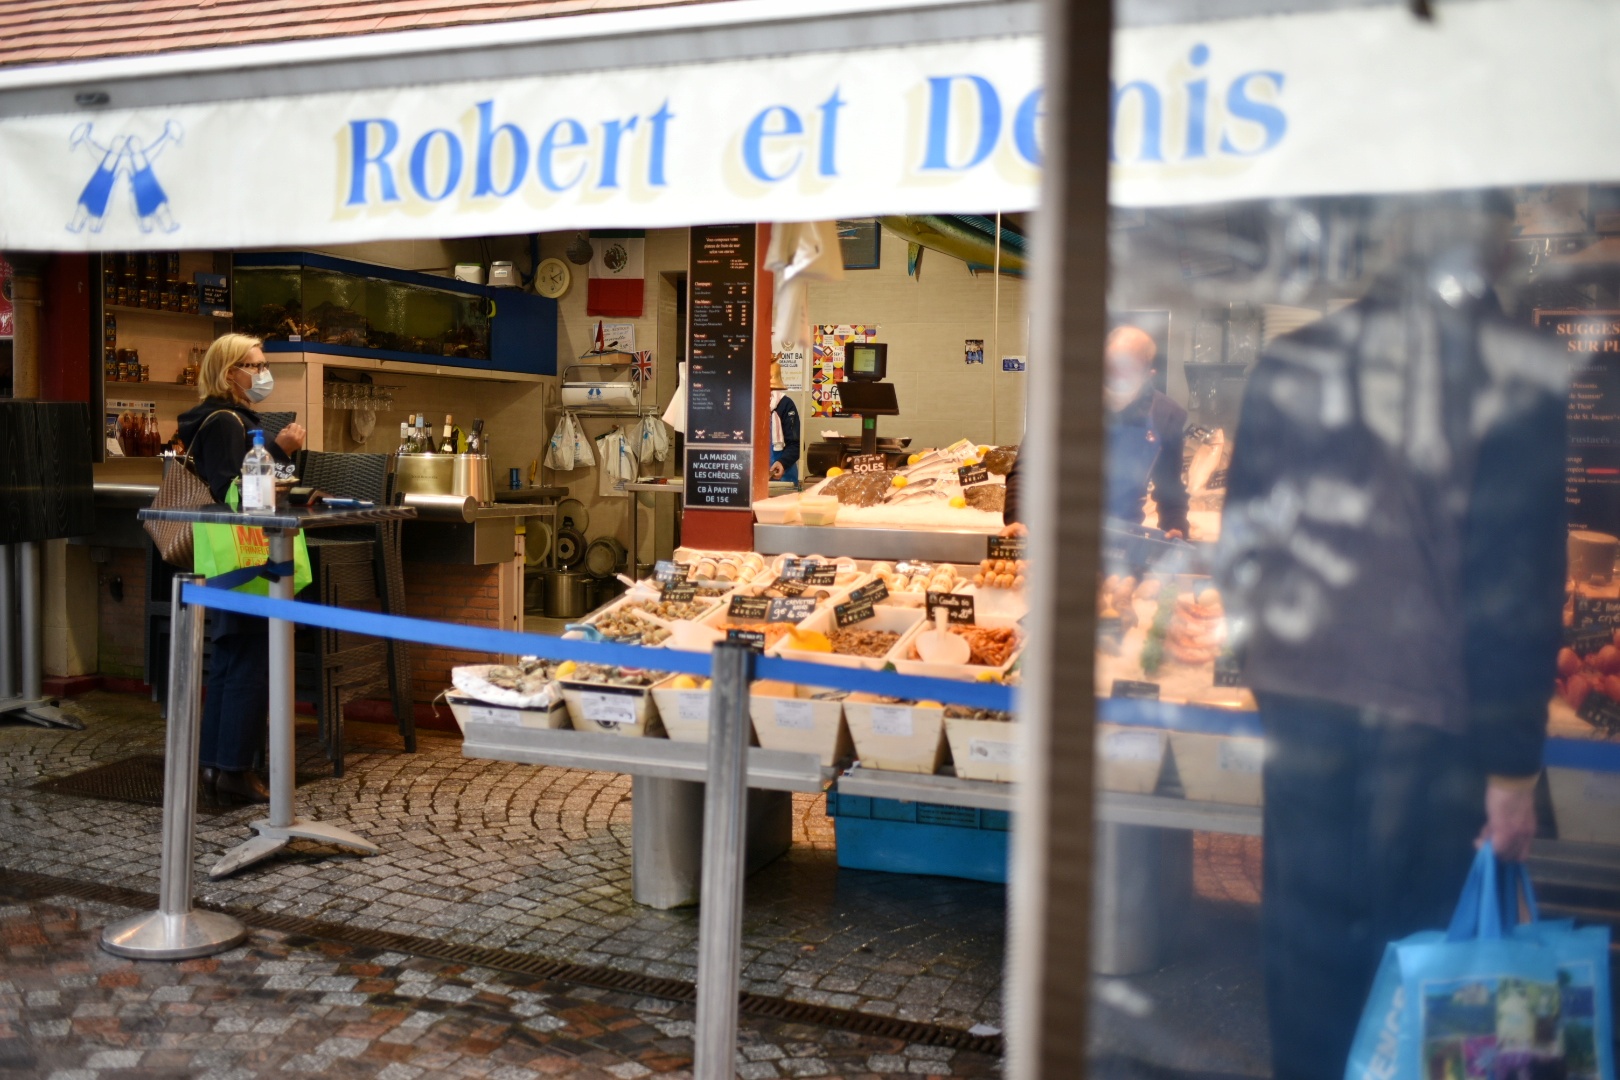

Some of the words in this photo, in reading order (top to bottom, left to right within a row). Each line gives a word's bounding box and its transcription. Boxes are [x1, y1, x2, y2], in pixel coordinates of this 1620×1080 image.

[343, 97, 677, 206] Robert
[741, 83, 846, 182] et
[1568, 340, 1599, 352] SUR
[1569, 434, 1610, 444] rustacés
[692, 462, 729, 470] N'ACCEPTE
[853, 462, 885, 473] SOLES
[707, 485, 713, 493] À
